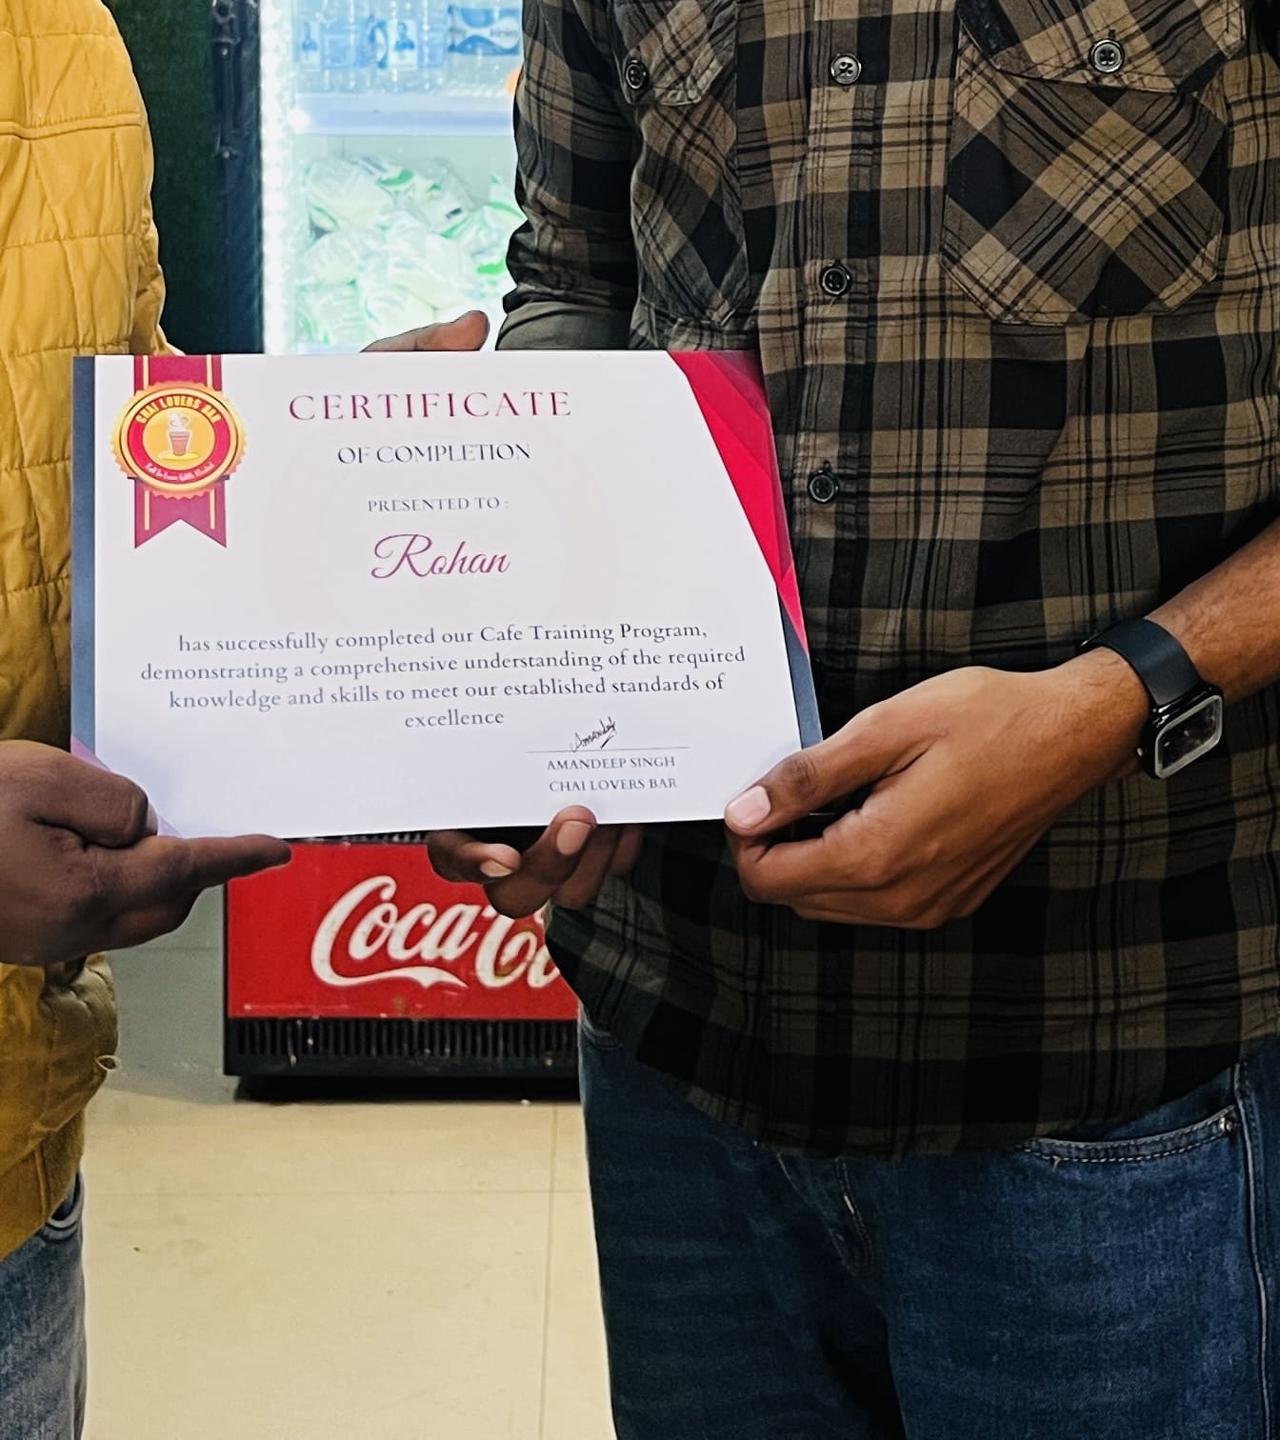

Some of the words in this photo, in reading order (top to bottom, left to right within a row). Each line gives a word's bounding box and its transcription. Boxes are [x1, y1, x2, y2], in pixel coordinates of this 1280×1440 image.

[289, 391, 571, 420] CERTIFICATE
[337, 446, 370, 464] OF
[376, 443, 531, 463] COMPLETION
[368, 496, 470, 512] PRESENTED
[474, 496, 500, 510] TO
[371, 533, 511, 578] Rohan
[178, 634, 210, 652] has
[216, 632, 328, 653] successfully
[335, 628, 435, 651] completed
[442, 631, 473, 643] our
[480, 624, 523, 642] Cafe
[528, 624, 615, 645] Training
[620, 623, 708, 644] Program,
[141, 663, 288, 683] demonstrating
[294, 666, 304, 677] a
[310, 656, 458, 680] comprehensive
[465, 650, 603, 671] understanding
[609, 648, 628, 666] of
[633, 649, 663, 665] the
[669, 646, 746, 669] required
[170, 690, 281, 712] knowledge
[288, 687, 324, 706] and
[330, 685, 379, 704] skills
[385, 687, 405, 701] to
[411, 683, 459, 700] meet
[465, 685, 497, 697] our
[504, 677, 606, 696] established
[611, 674, 700, 693] standards
[705, 671, 727, 691] of
[405, 709, 505, 728] excellence
[547, 757, 627, 771] AMANDEEP
[630, 755, 676, 769] SINGH
[549, 779, 586, 792] CHAI
[589, 778, 646, 791] LOVERS
[649, 777, 678, 789] BAR
